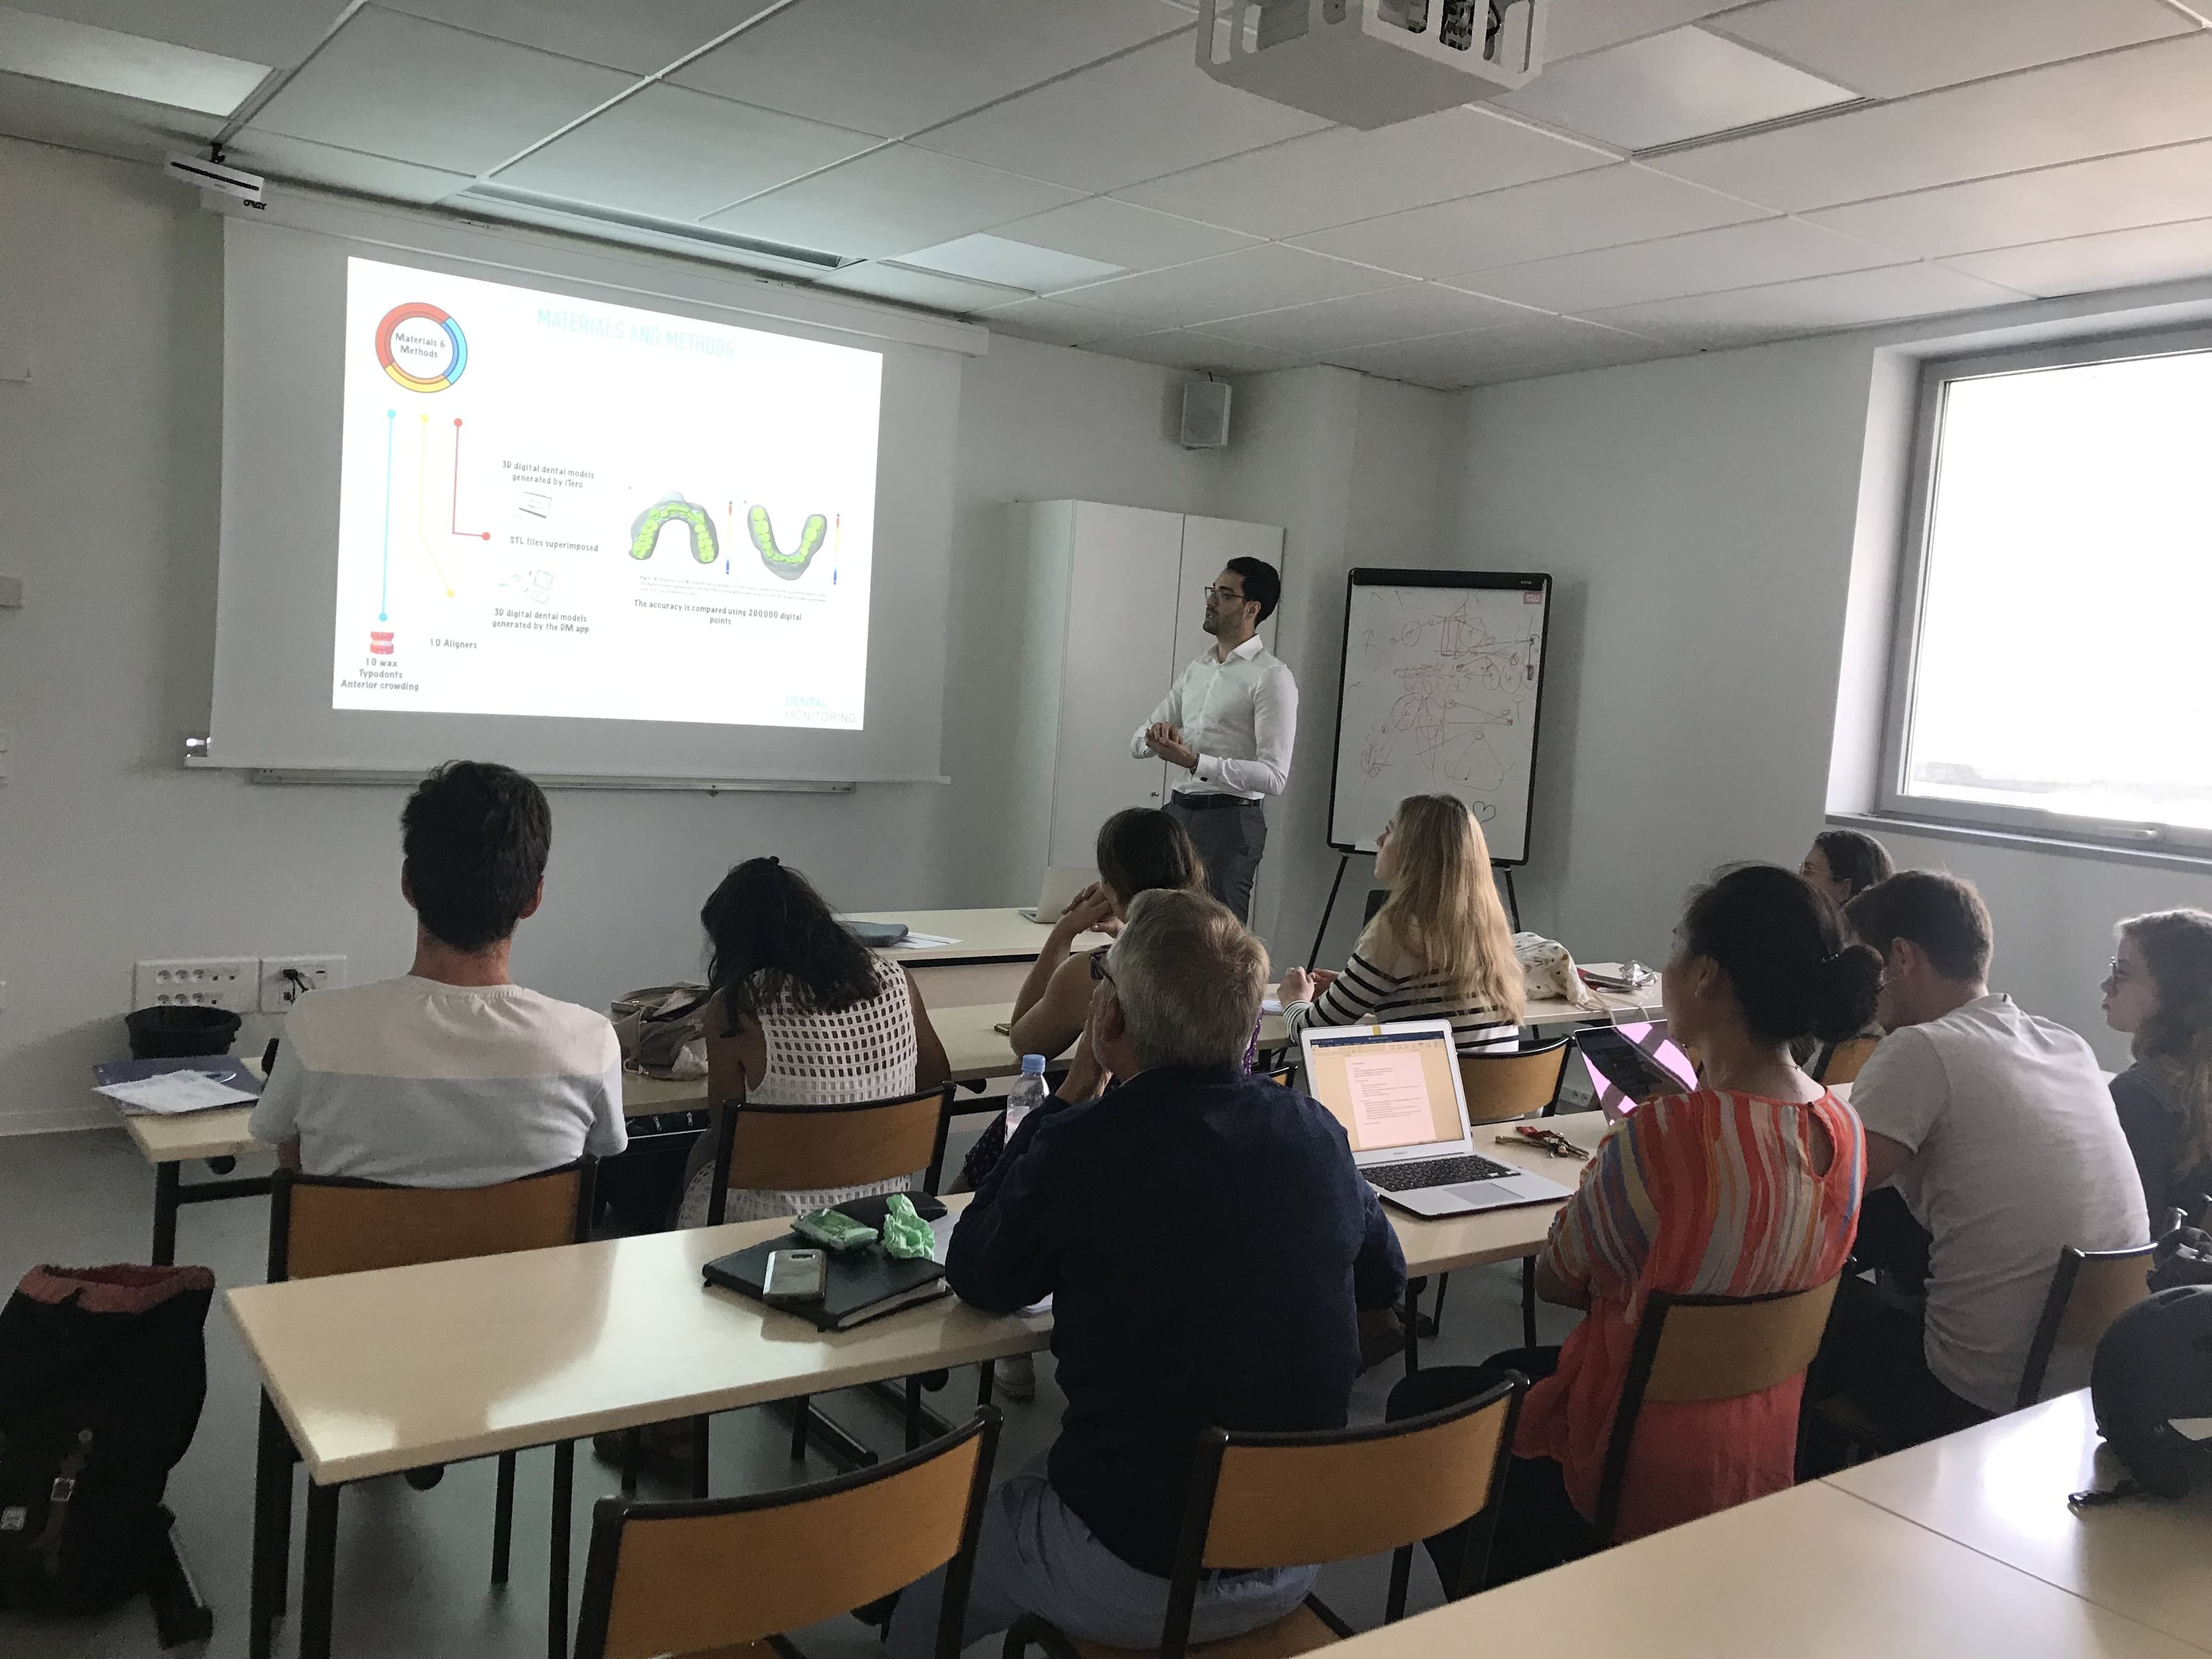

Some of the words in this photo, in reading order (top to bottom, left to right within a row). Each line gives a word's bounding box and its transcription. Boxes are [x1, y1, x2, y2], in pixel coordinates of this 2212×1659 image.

[395, 332, 438, 347] Materials
[440, 340, 446, 348] &
[538, 308, 624, 340] MATERIALS
[630, 324, 659, 346] AND
[665, 331, 735, 358] METHODS
[400, 344, 438, 358] Methods
[502, 460, 512, 469] 3D
[514, 463, 539, 472] digital
[541, 465, 566, 475] dental
[568, 469, 594, 479] models
[512, 474, 551, 484] generated
[553, 478, 562, 486] by
[565, 479, 583, 488] iTero
[510, 536, 524, 544] STL
[527, 537, 543, 546] files
[546, 541, 599, 552] superimposed
[494, 608, 504, 616] 3D
[506, 609, 532, 619] digital
[534, 611, 558, 620] dental
[560, 613, 587, 622] models
[634, 599, 647, 608] The
[649, 602, 682, 611] accuracy
[692, 605, 726, 615] compared
[728, 608, 746, 617] using
[780, 612, 802, 621] digital
[492, 620, 531, 629] generated
[534, 622, 543, 631] by
[546, 623, 558, 631] the
[560, 624, 573, 632] DM
[575, 626, 589, 634] app
[710, 616, 732, 625] points
[430, 638, 441, 647] 10
[444, 639, 477, 649] Aligners
[366, 658, 377, 666] 10
[359, 669, 403, 679] Typodonts
[340, 680, 378, 689] Anterior
[380, 681, 419, 692] crowding
[785, 695, 828, 709] DENTAL
[785, 710, 856, 724] MONITORING
